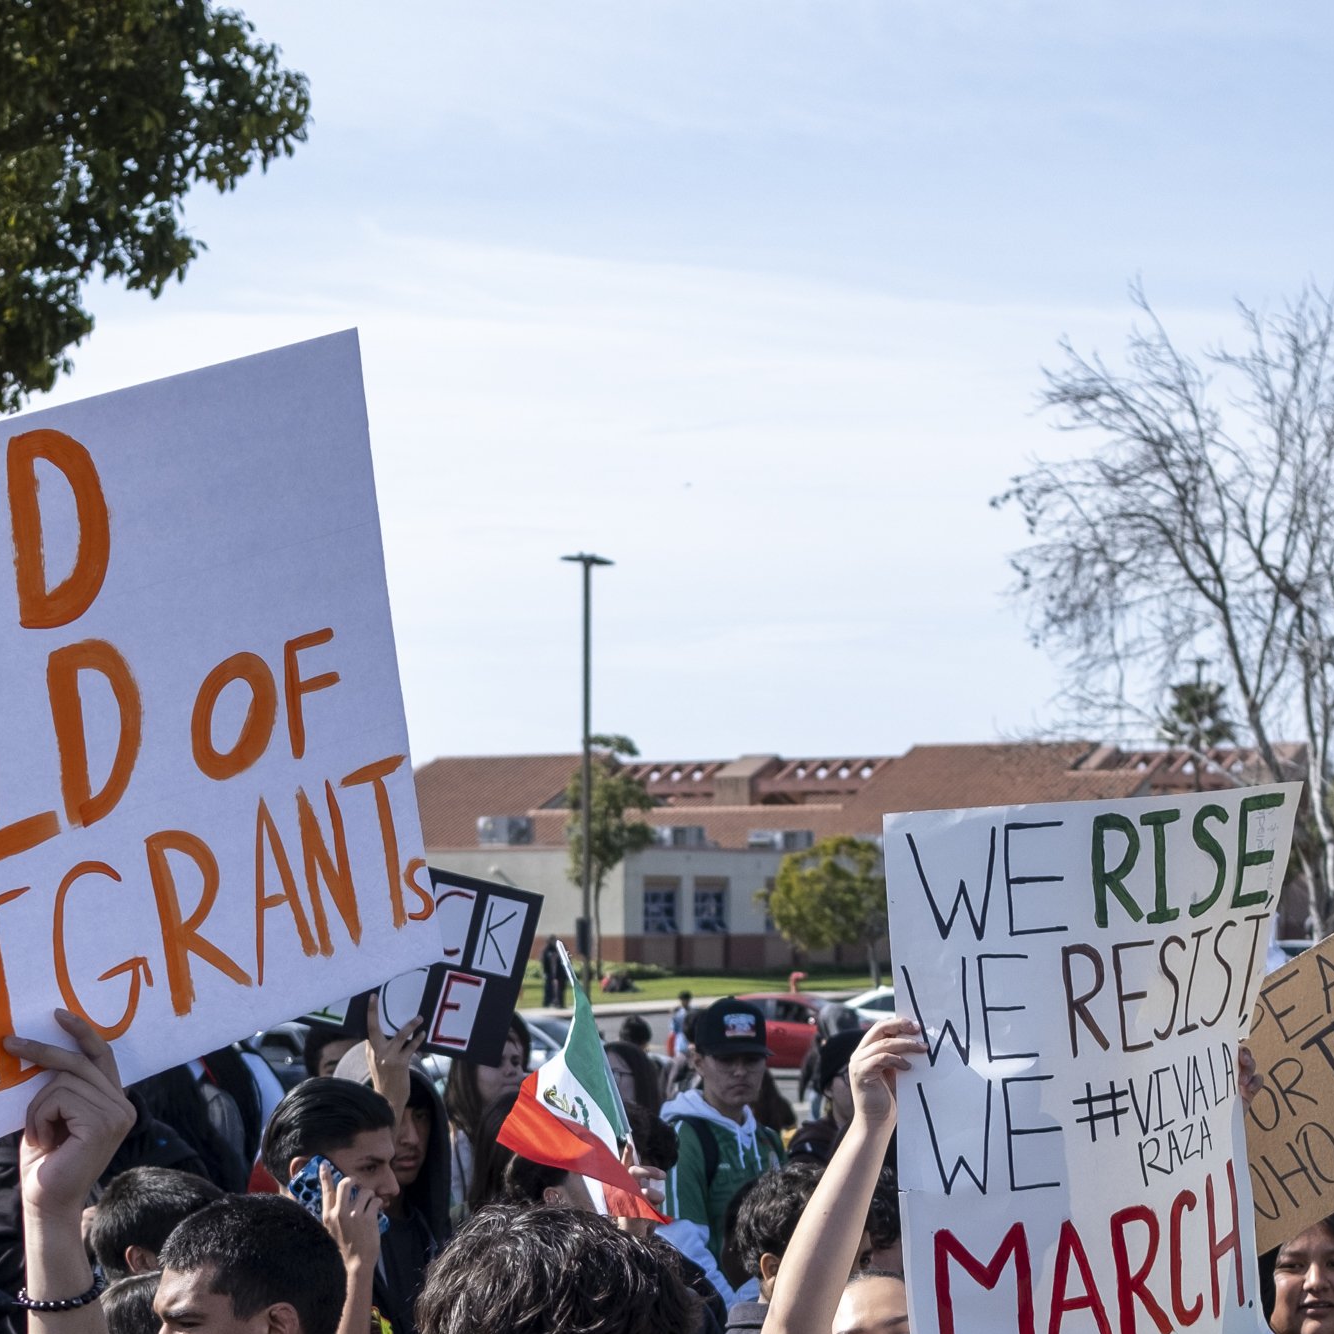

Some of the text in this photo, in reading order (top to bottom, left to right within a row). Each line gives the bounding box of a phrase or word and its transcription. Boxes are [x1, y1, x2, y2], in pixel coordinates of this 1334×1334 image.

[192, 626, 340, 782] OF
[906, 821, 1068, 940] WE
[901, 953, 1040, 1067] WE
[917, 1074, 1063, 1195] WE
[1248, 1057, 1318, 1132] OR
[1137, 1123, 1213, 1187] RAZA
